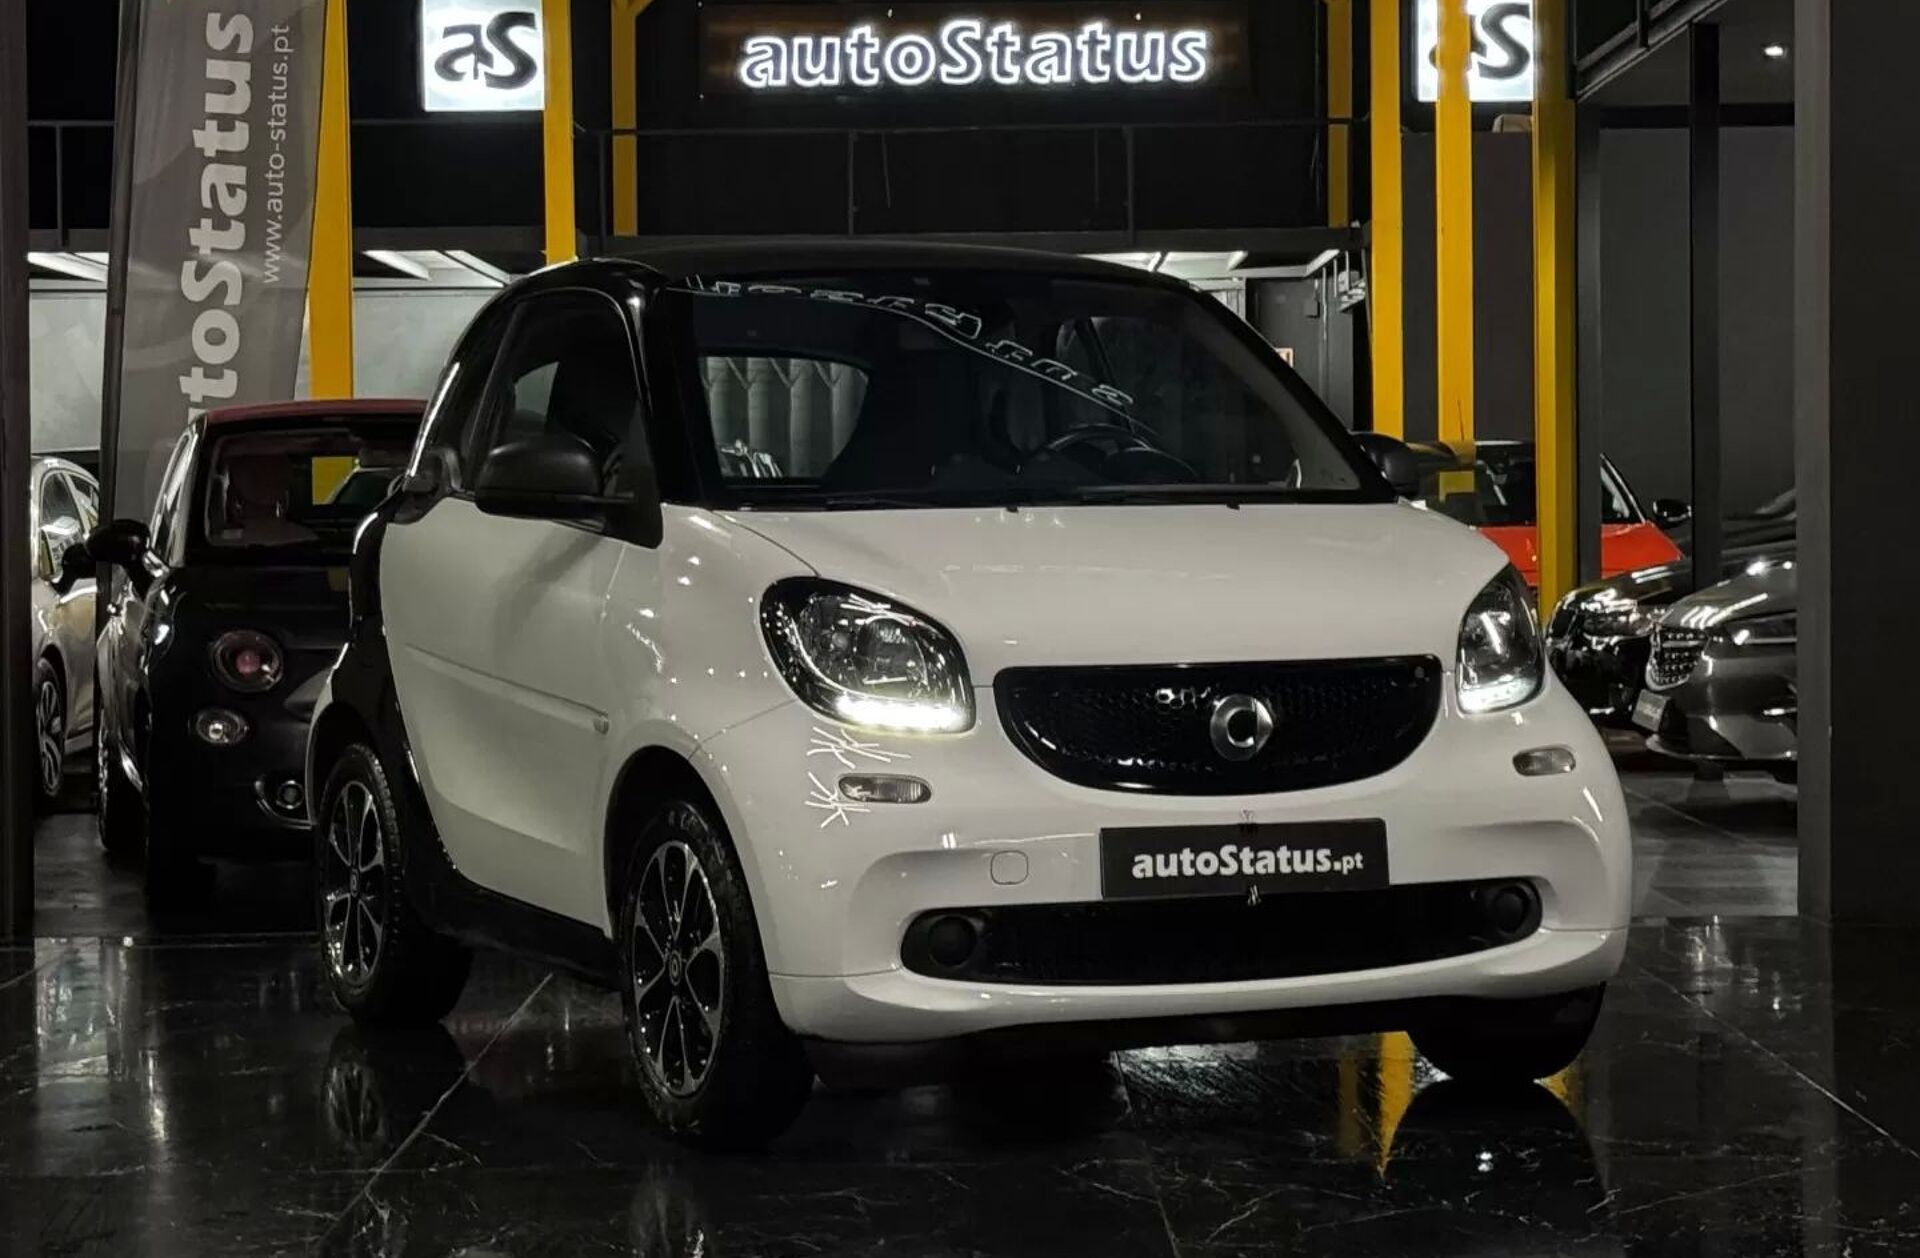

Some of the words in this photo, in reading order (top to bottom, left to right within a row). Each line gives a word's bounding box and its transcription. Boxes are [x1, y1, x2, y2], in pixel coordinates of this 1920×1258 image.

[741, 19, 1209, 87] autoStatus
[179, 12, 254, 424] toStatus
[263, 24, 294, 284] www.auto-status.pt
[1132, 844, 1364, 879] autoStatus.pt
